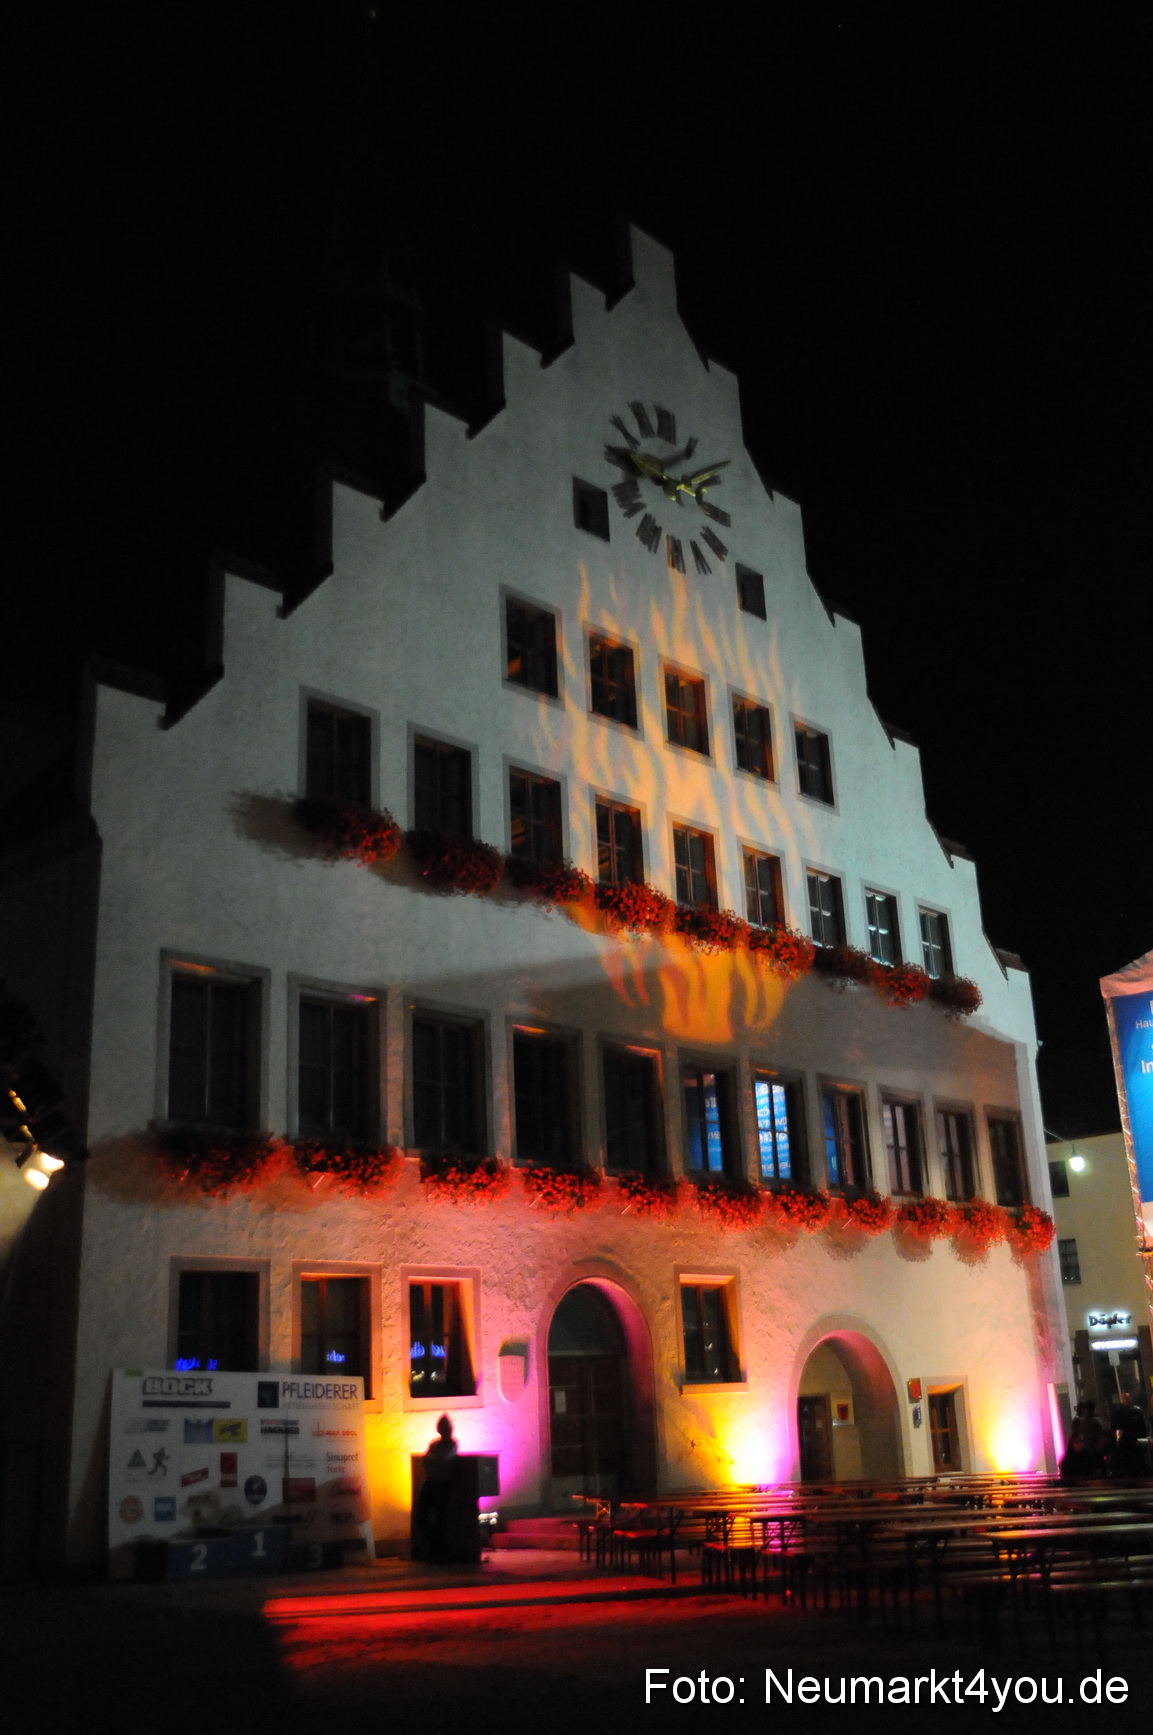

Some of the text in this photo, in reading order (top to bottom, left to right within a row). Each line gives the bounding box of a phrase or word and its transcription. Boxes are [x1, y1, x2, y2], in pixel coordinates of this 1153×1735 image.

[142, 1377, 213, 1396] BOCK
[282, 1381, 358, 1400] PFLEIDERER
[253, 1531, 267, 1557] 1
[190, 1543, 208, 1571] 2
